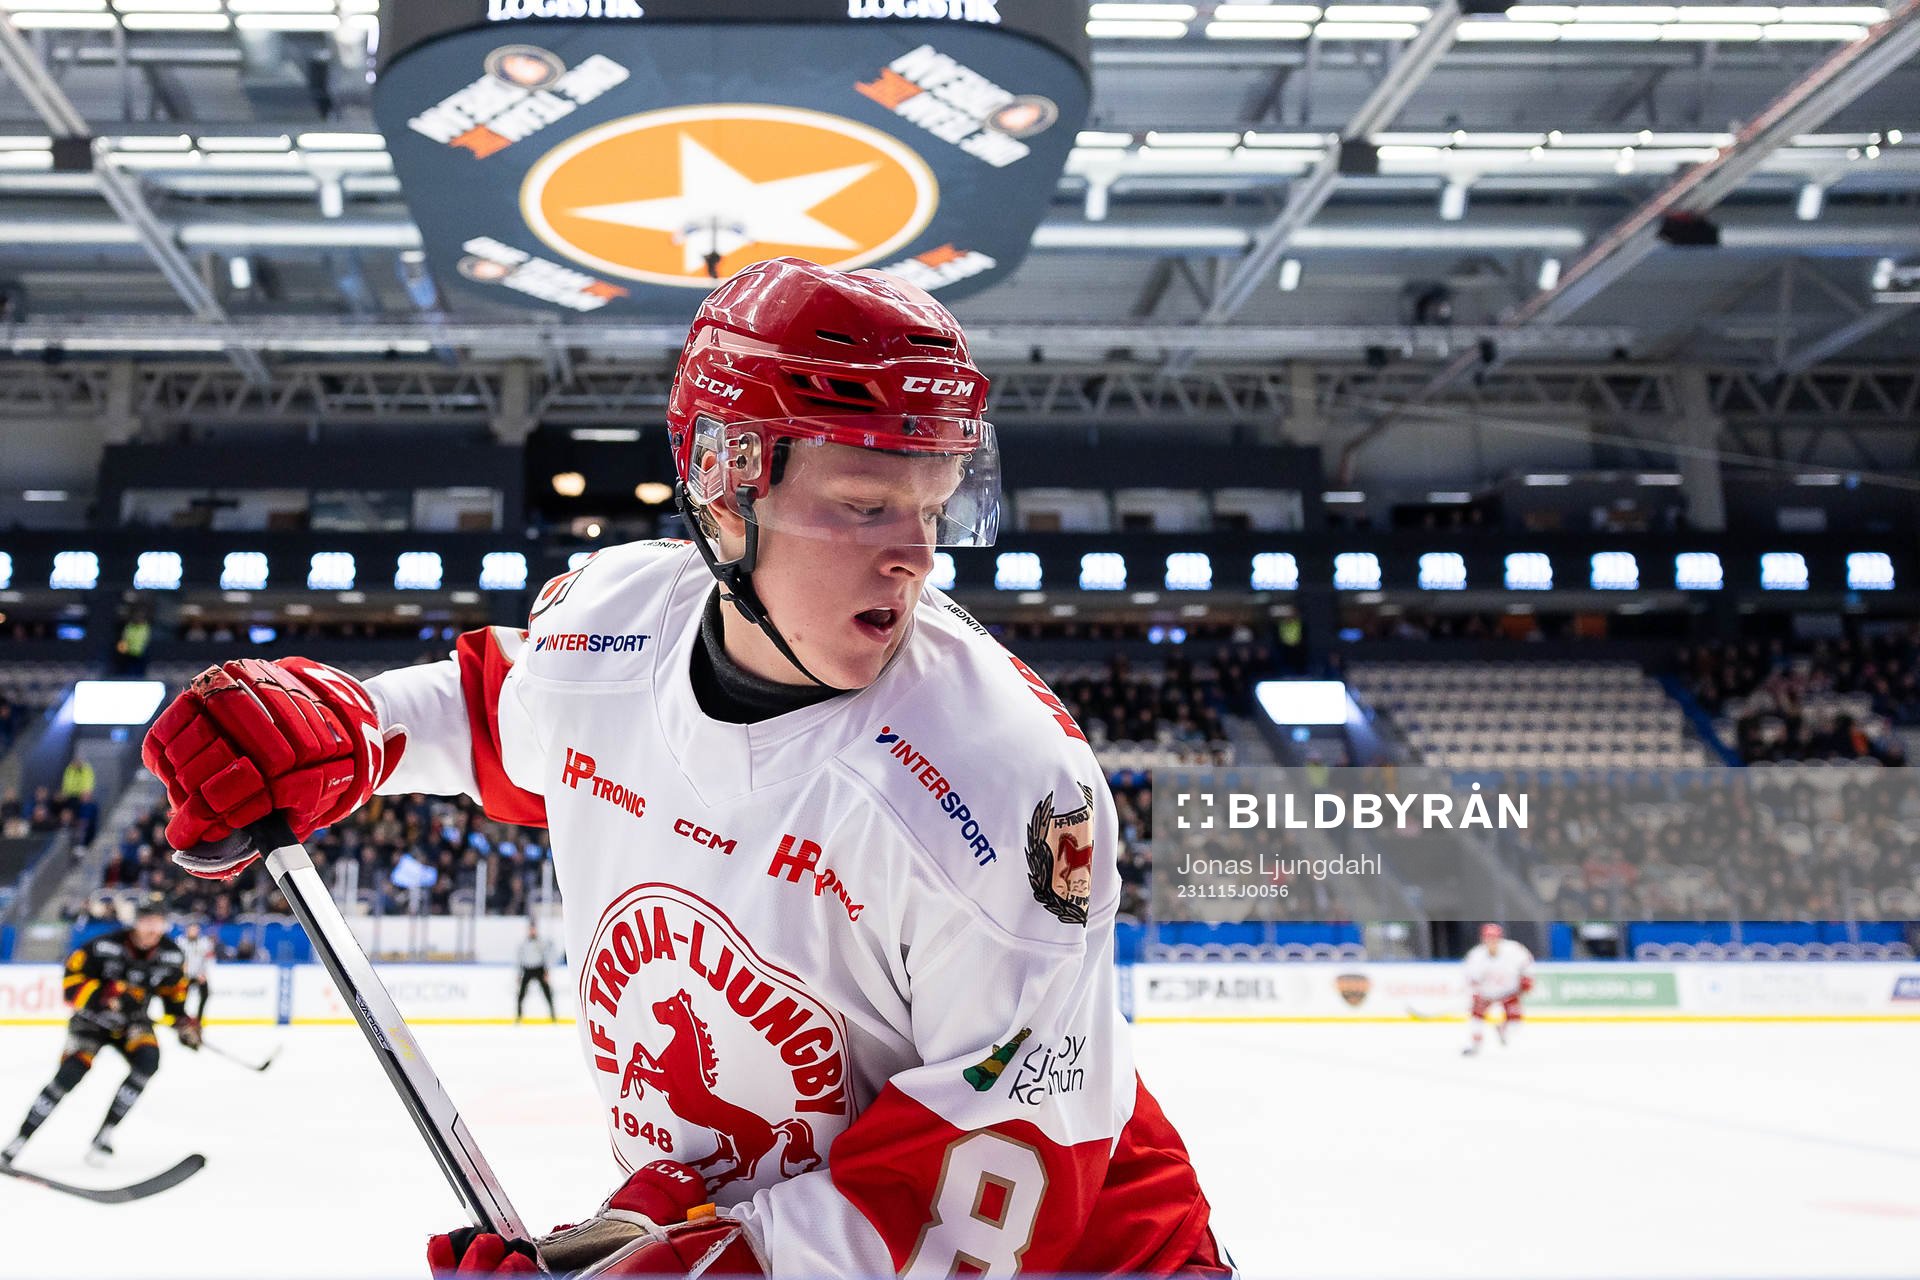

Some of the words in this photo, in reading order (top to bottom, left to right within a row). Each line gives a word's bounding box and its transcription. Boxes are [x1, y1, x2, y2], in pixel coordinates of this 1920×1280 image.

[694, 374, 743, 400] CCM
[902, 375, 975, 397] CCM
[545, 633, 649, 652] INTERSPORT
[889, 739, 998, 867] INTERSPORT
[673, 818, 738, 856] CCM
[589, 906, 847, 1116] TROJA-LJUNGBY
[589, 1019, 620, 1075] IF
[611, 1105, 674, 1154] 1948
